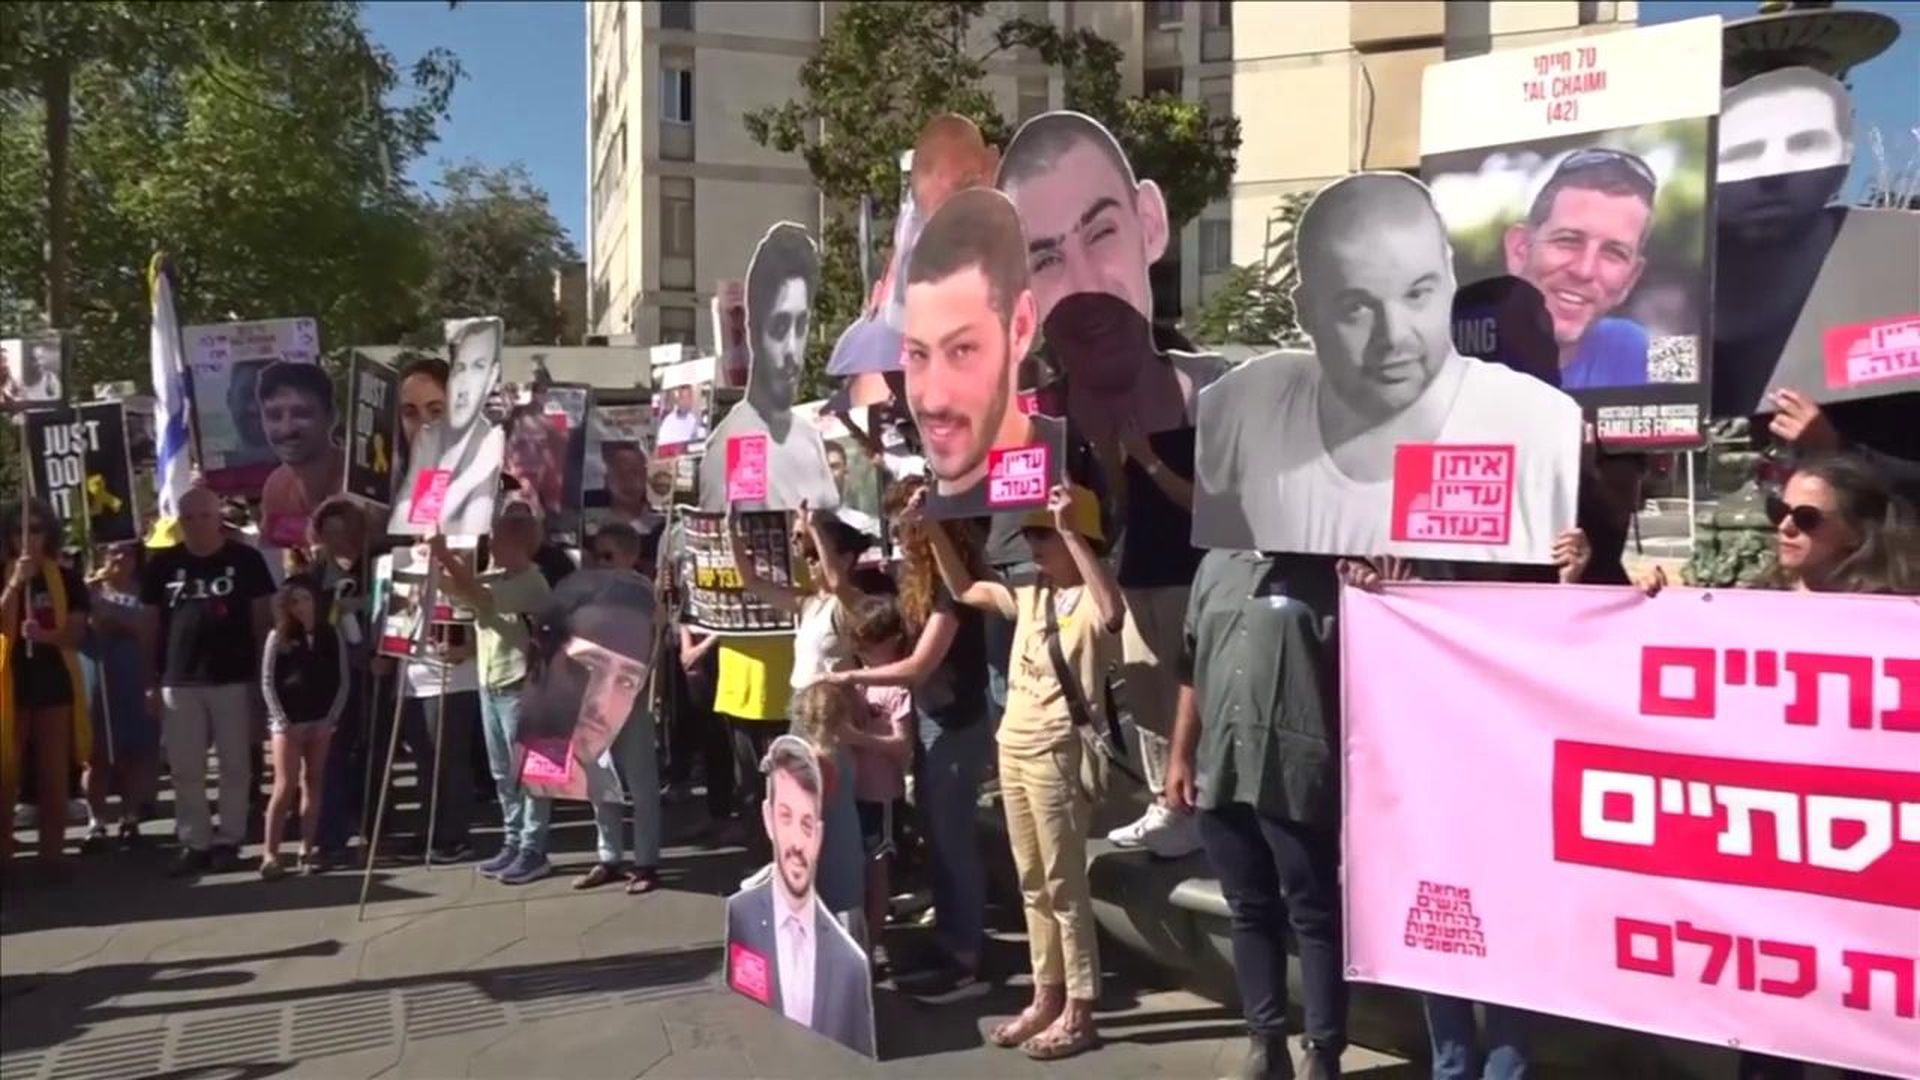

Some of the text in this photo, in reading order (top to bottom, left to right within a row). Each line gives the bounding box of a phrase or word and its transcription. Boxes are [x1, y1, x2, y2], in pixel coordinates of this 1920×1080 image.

[1576, 47, 1597, 69] טל
[1552, 71, 1607, 98] CHAIMI
[1547, 99, 1579, 125] (42)
[1451, 317, 1497, 354] ING
[43, 420, 100, 457] JUST
[46, 455, 80, 488] DO
[1440, 455, 1503, 480] איתן
[50, 486, 72, 519] IT
[1436, 485, 1502, 508] עדיין
[1417, 515, 1500, 537] בעזה.
[164, 576, 234, 608] 7.10
[1615, 916, 1819, 1000] כולם
